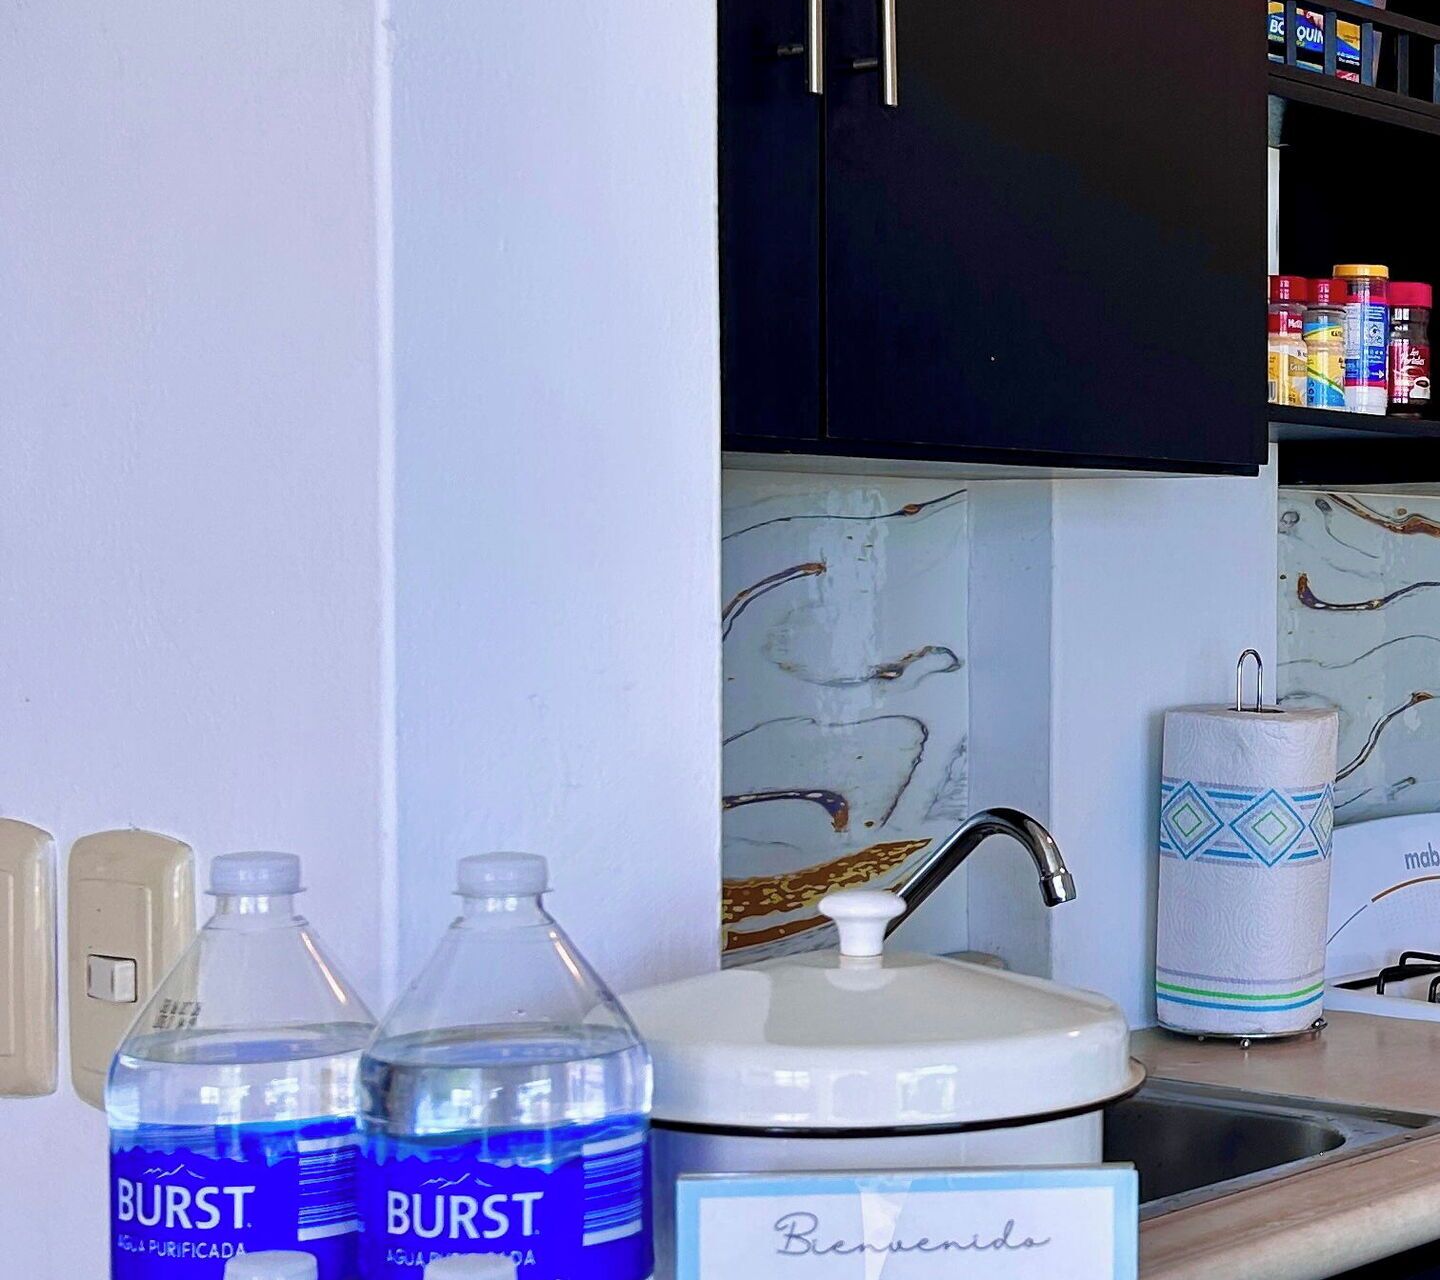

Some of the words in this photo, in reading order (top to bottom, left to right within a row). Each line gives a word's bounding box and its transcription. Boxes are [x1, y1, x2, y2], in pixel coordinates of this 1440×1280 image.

[118, 1177, 256, 1230] BURST
[386, 1190, 545, 1240] BURST
[149, 1240, 248, 1260] PURIFICADA
[773, 1211, 1053, 1257] Bienvenido
